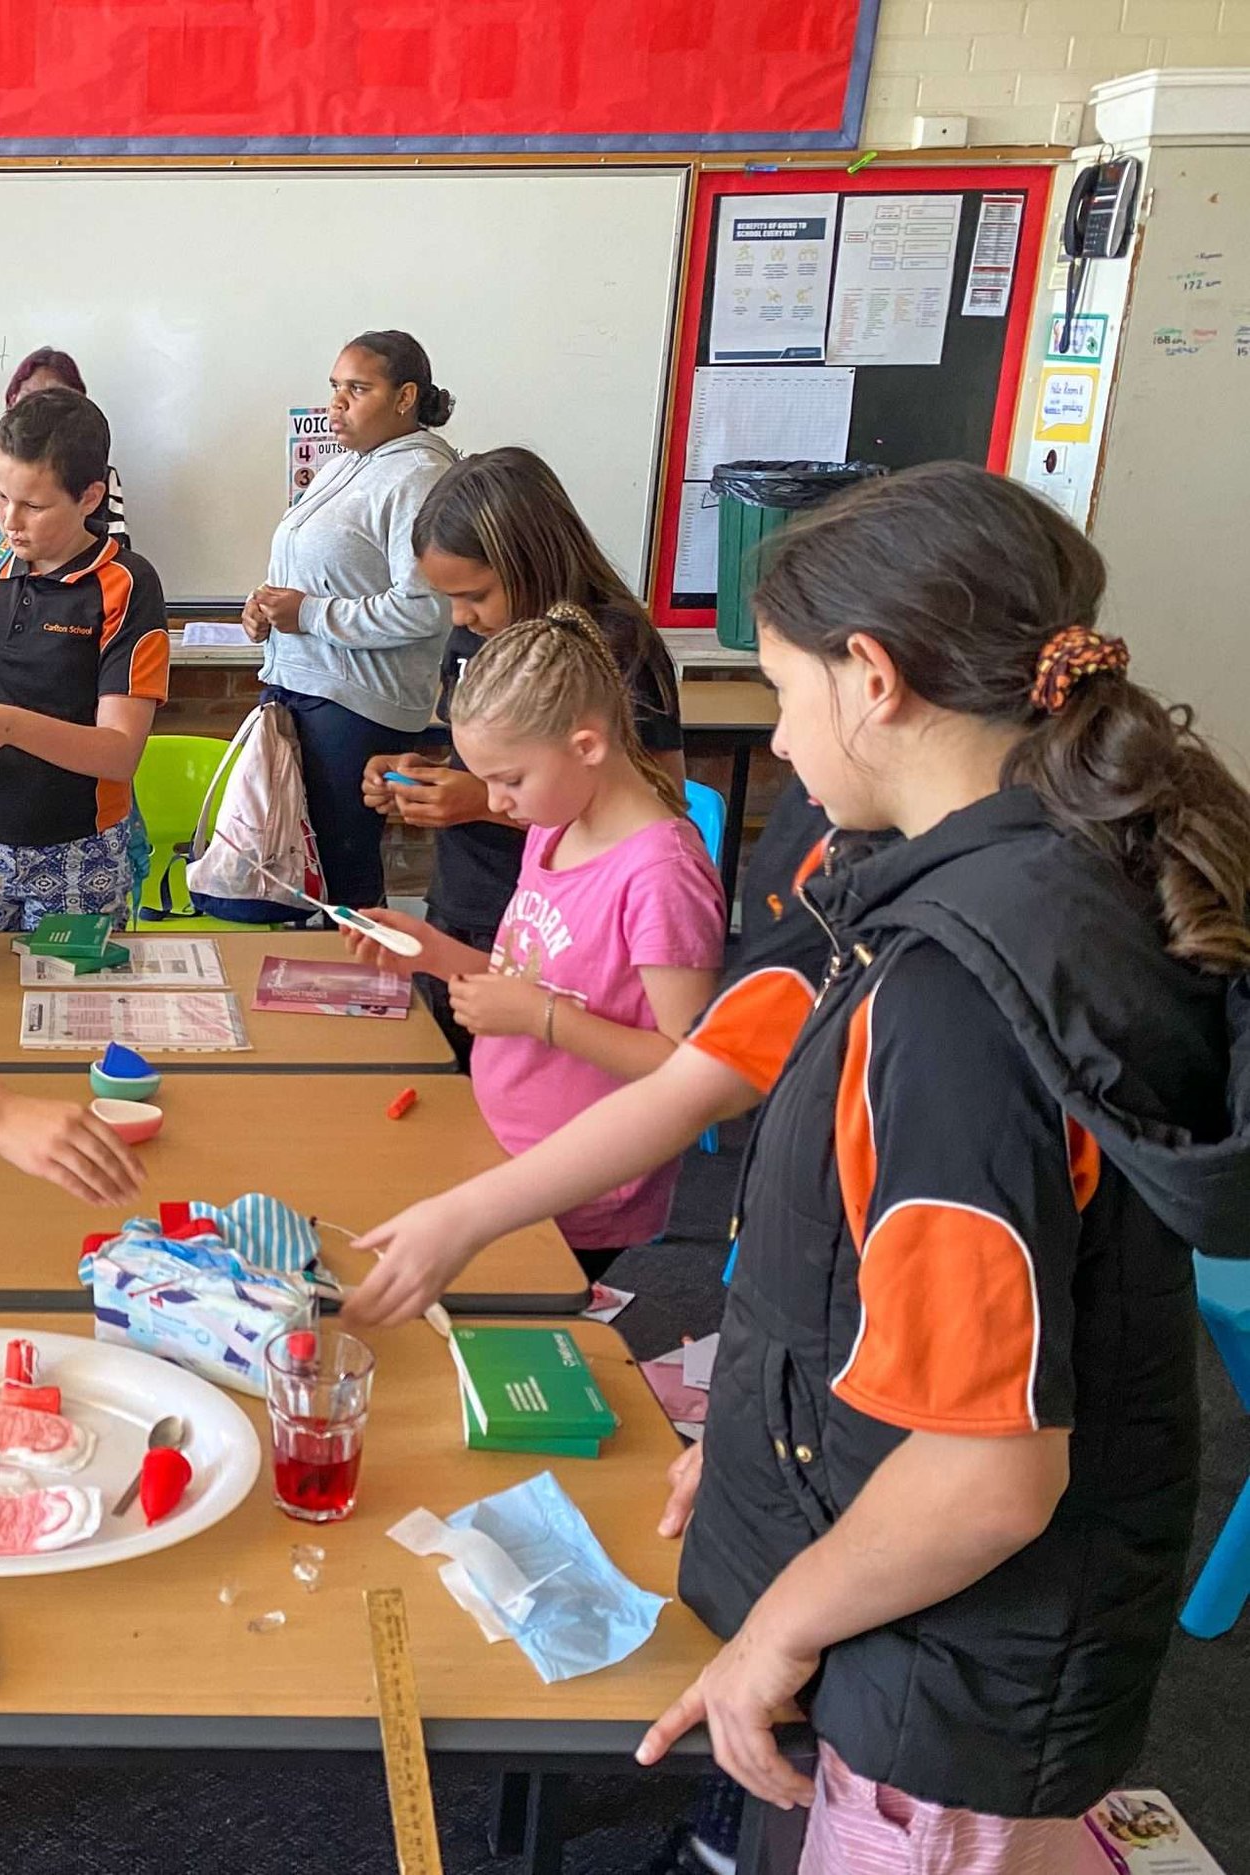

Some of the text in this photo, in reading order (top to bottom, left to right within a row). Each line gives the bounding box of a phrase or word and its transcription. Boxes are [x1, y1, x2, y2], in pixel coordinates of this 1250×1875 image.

[293, 416, 334, 435] VOIC
[299, 445, 311, 462] 4
[299, 469, 311, 486] 3
[43, 623, 93, 635] Carlton School
